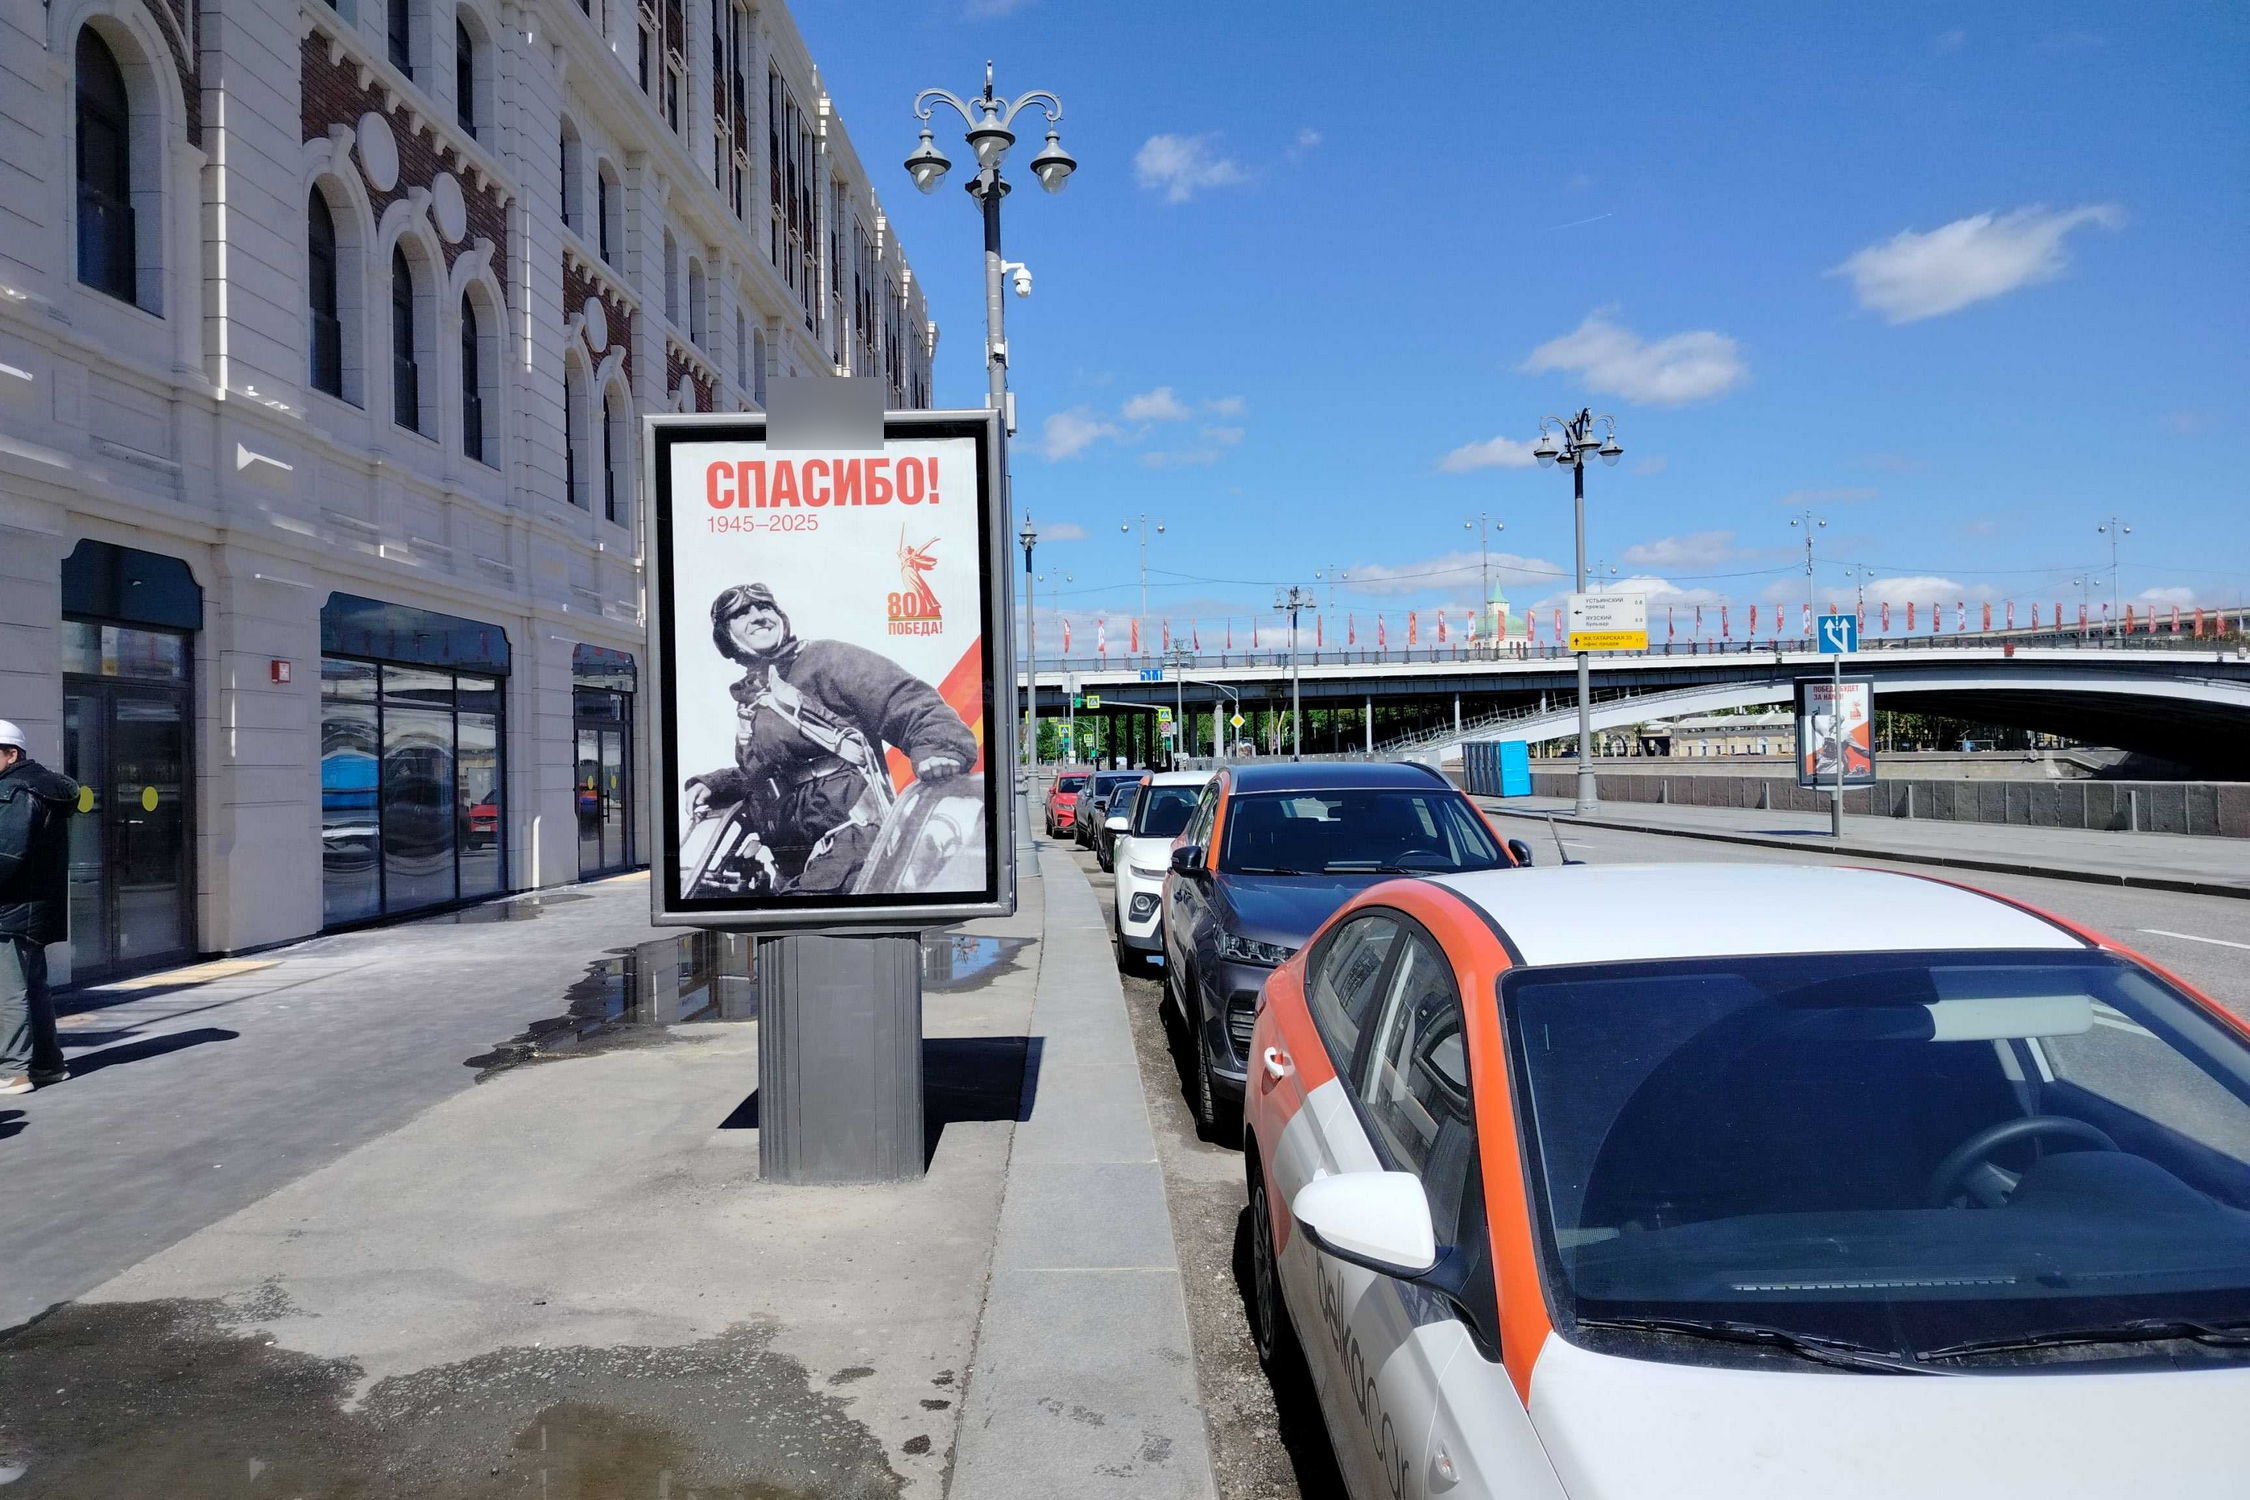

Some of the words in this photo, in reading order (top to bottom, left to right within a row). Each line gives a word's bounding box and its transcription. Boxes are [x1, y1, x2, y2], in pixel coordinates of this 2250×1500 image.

[706, 456, 940, 509] СПАСИБО!
[887, 591, 919, 618] 80
[887, 620, 943, 637] ПОБЕДА!
[1813, 685, 1837, 693] ПОБЕД
